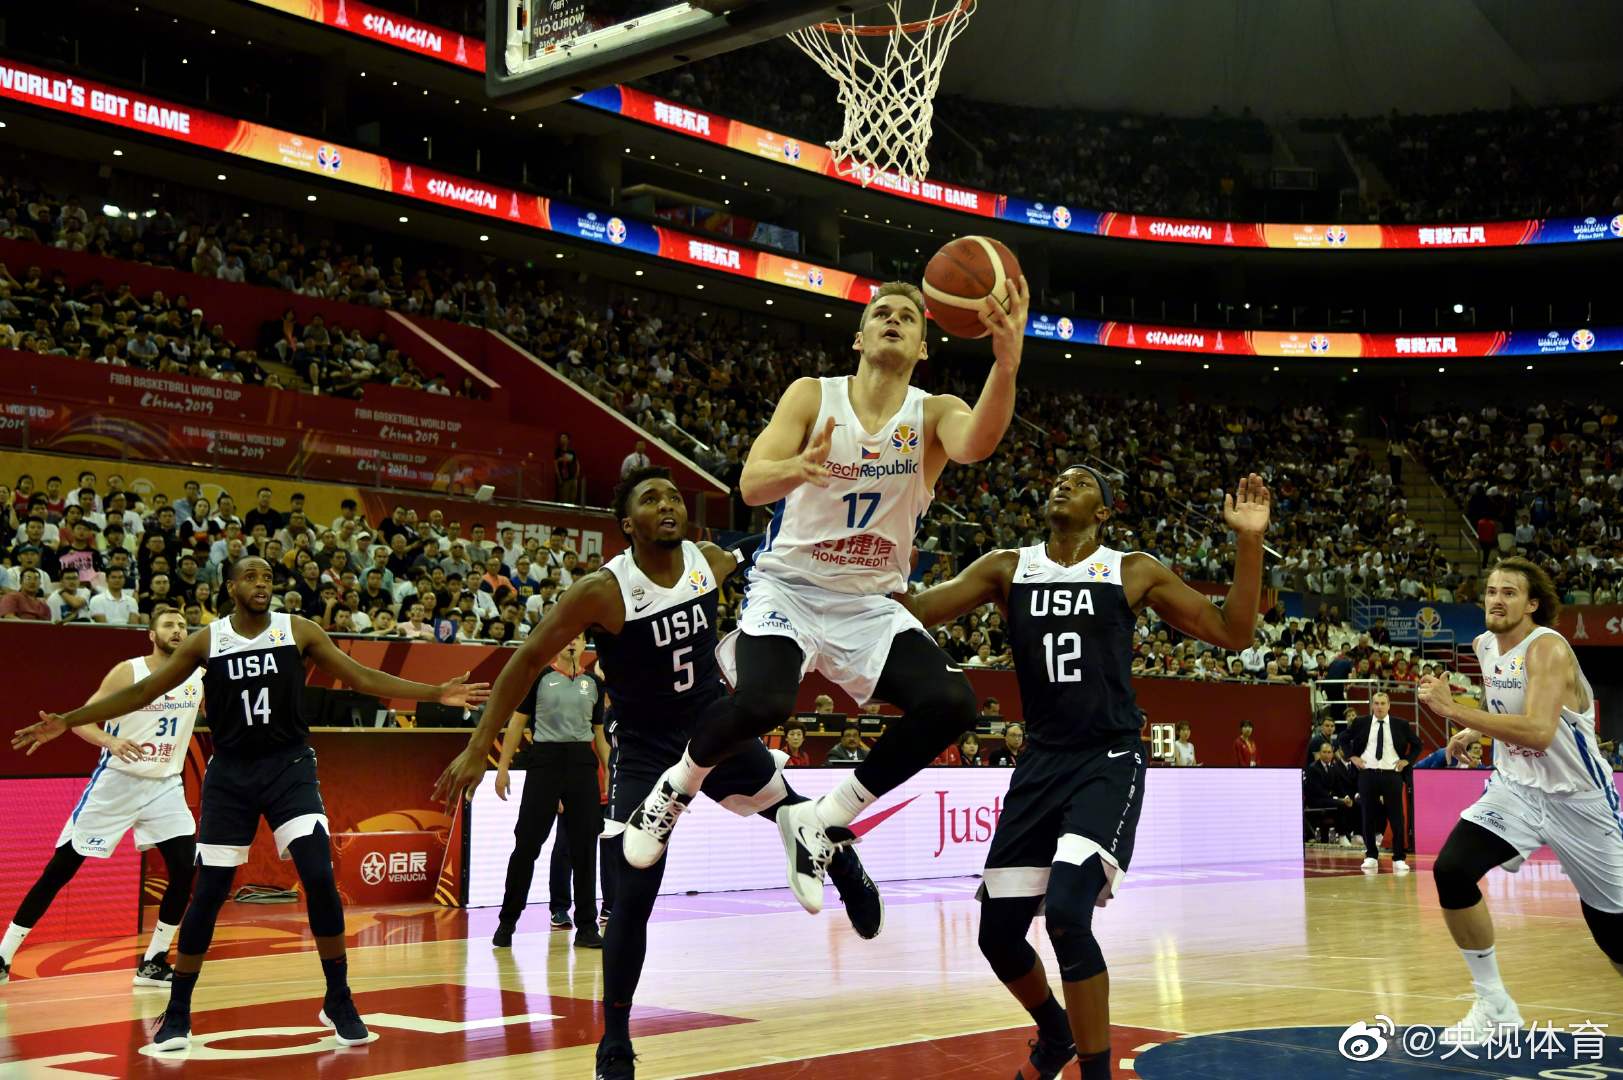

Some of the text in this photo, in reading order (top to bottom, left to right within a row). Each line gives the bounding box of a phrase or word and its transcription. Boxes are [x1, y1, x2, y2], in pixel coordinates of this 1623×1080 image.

[362, 13, 442, 52] SHANGHAI
[91, 90, 129, 118] GOT
[133, 101, 190, 134] GAME
[654, 101, 711, 136] 有我不凡
[426, 178, 497, 210] SHANGHAI
[922, 183, 943, 201] GOT
[945, 188, 978, 209] GAME
[1149, 222, 1212, 240] SHANGHAI
[1418, 226, 1486, 245] 有我不凡
[1145, 331, 1204, 348] SHANGHAI
[1395, 337, 1458, 354] 有我不凡
[110, 372, 242, 401] FIBA BASKETBALL WORLD CUP
[140, 392, 214, 414] China 2019
[355, 408, 462, 432] FIBA BASKETBALL WORLD CUP
[201, 428, 245, 442] BASETBALL
[379, 425, 440, 446] China 2019
[207, 441, 265, 460] Cina 2019
[842, 492, 881, 529] 17
[812, 550, 889, 567] HOME CREDIT
[1030, 588, 1095, 617] USA
[651, 603, 709, 647] USA
[227, 652, 279, 680] USA
[672, 645, 695, 693] 5
[1042, 631, 1082, 683] 12
[241, 687, 272, 726] 14
[155, 716, 179, 737] 31
[934, 790, 1004, 858] Just
[388, 851, 427, 874] 启辰
[388, 873, 427, 883] VENUCIA
